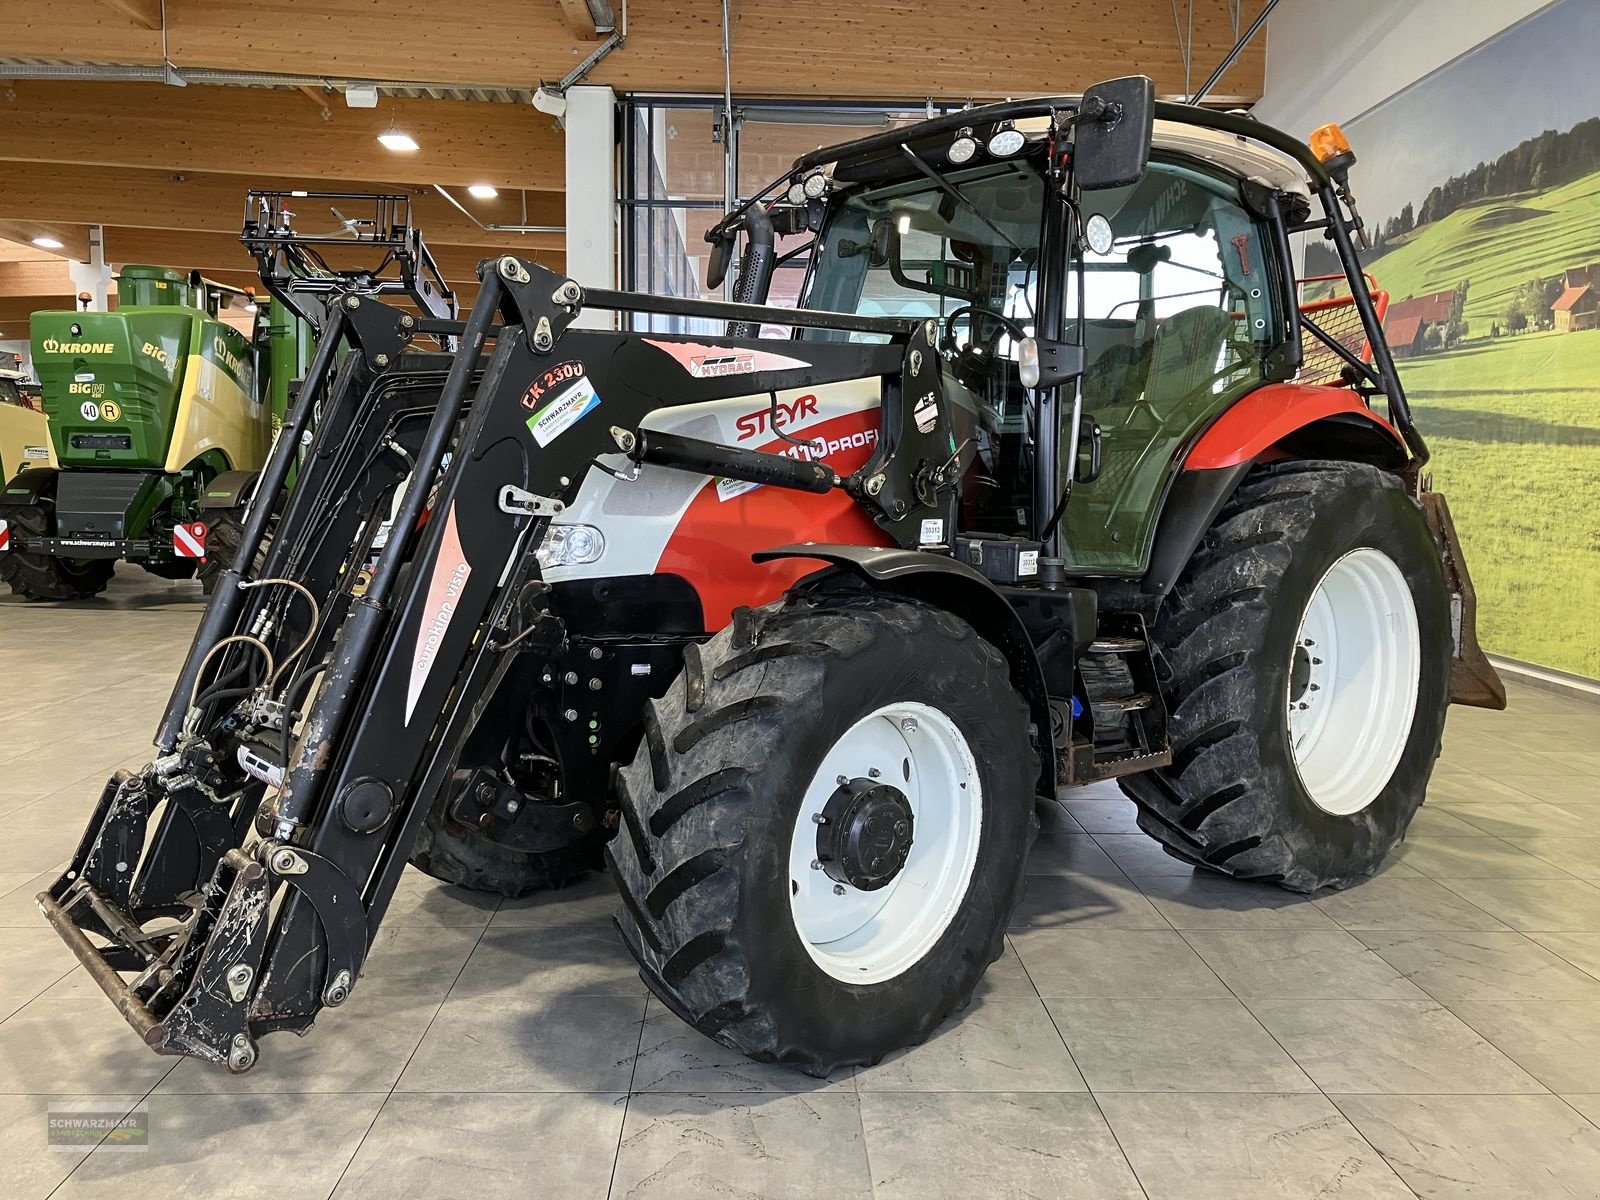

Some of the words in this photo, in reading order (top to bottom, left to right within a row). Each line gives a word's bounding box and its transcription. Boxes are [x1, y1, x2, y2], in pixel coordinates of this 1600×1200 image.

[60, 343, 114, 353] KRONE
[544, 363, 583, 388] 2300
[701, 362, 752, 376] HYDRAC
[69, 383, 91, 394] BiG
[83, 404, 97, 418] 40
[104, 404, 115, 417] R
[537, 391, 583, 429] SCHWARZMAYR
[736, 394, 819, 442] STEYR
[828, 428, 880, 455] PROFI
[417, 602, 454, 670] eurokipp
[447, 563, 467, 597] visio
